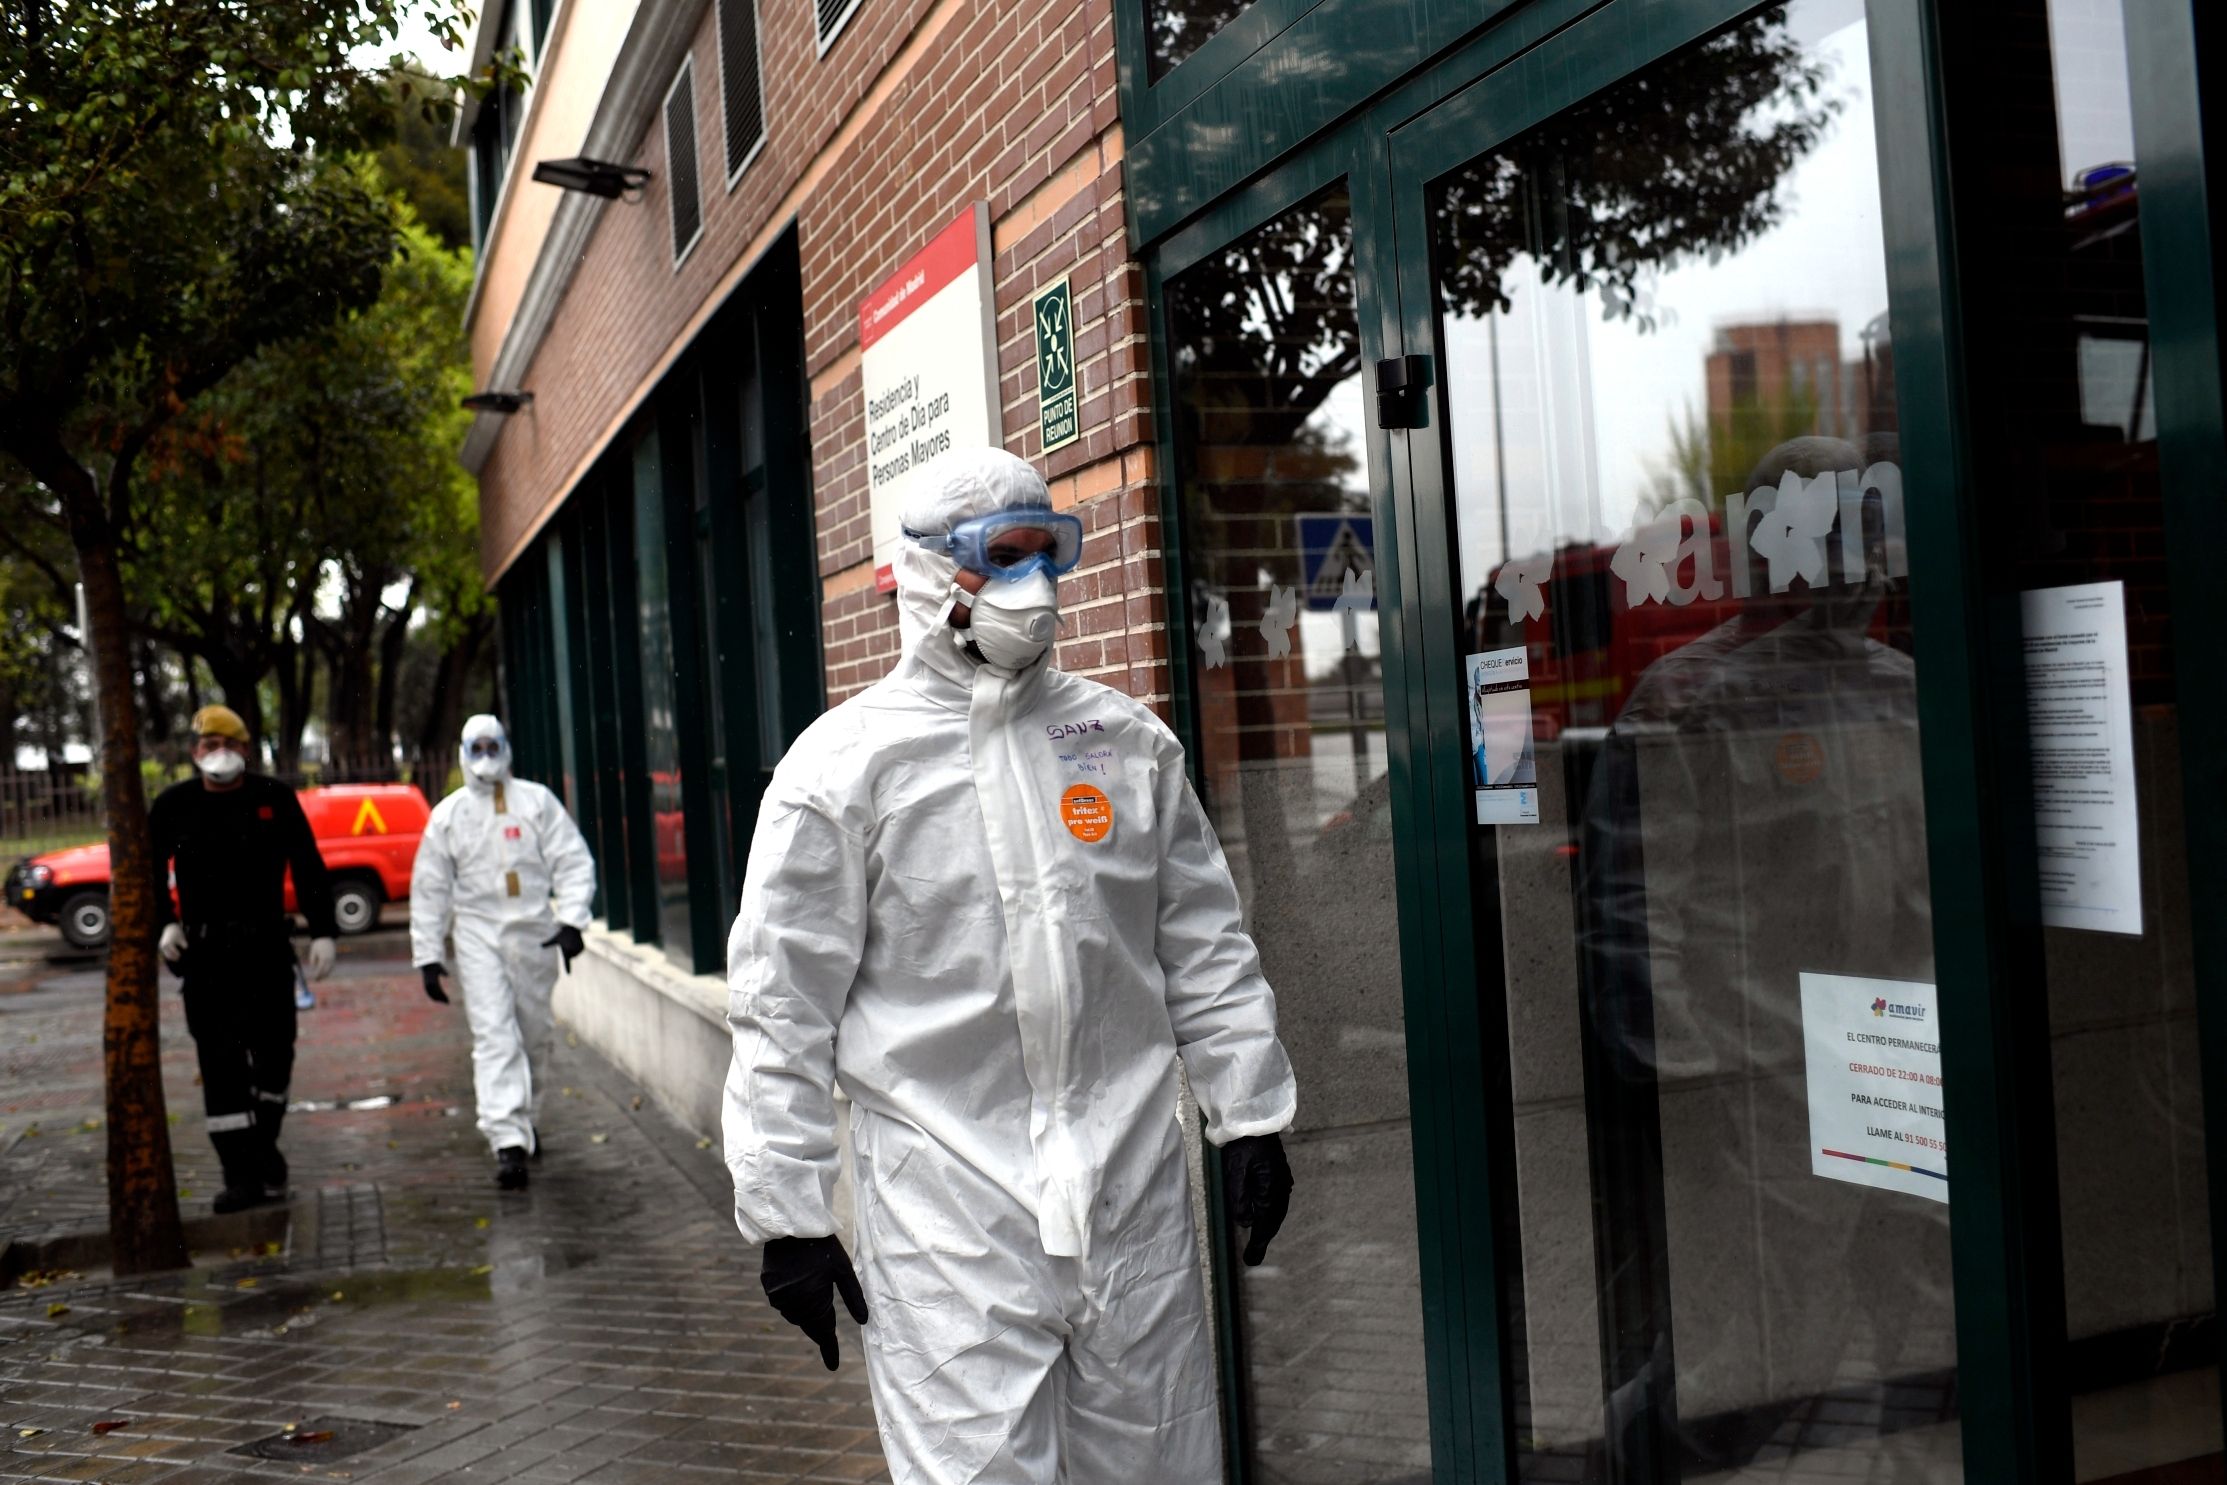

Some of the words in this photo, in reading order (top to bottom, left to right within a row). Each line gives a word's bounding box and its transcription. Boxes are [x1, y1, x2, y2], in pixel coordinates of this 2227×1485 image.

[869, 376, 912, 424] Residencia
[913, 374, 919, 400] y
[1044, 402, 1064, 425] PUNTO
[1063, 397, 1073, 415] DE
[871, 425, 896, 456] Centro
[898, 413, 909, 439] de
[911, 402, 926, 432] Día
[928, 392, 950, 428] para
[1046, 416, 1073, 443] REUNION
[872, 452, 909, 488] Personas
[911, 429, 950, 467] Mayores
[1480, 658, 1502, 670] CHEQUE
[1047, 719, 1105, 740] SANZ
[1067, 817, 1083, 827] pro
[1888, 1003, 1926, 1018] amavir
[1847, 1032, 1855, 1042] EL
[1856, 1033, 1887, 1045] CENTRO
[1849, 1062, 1885, 1076] CERRADO
[1886, 1068, 1897, 1078] DE
[1898, 1070, 1918, 1082] 22:00
[1919, 1073, 1925, 1084] A
[1851, 1093, 1872, 1104] PARA
[1873, 1097, 1907, 1111] ACCEDER
[1909, 1103, 1918, 1113] AL
[1867, 1126, 1893, 1139] LLAME
[1894, 1131, 1904, 1142] AL
[1904, 1133, 1914, 1143] 91
[1915, 1136, 1928, 1147] 500
[1929, 1139, 1938, 1149] 55
